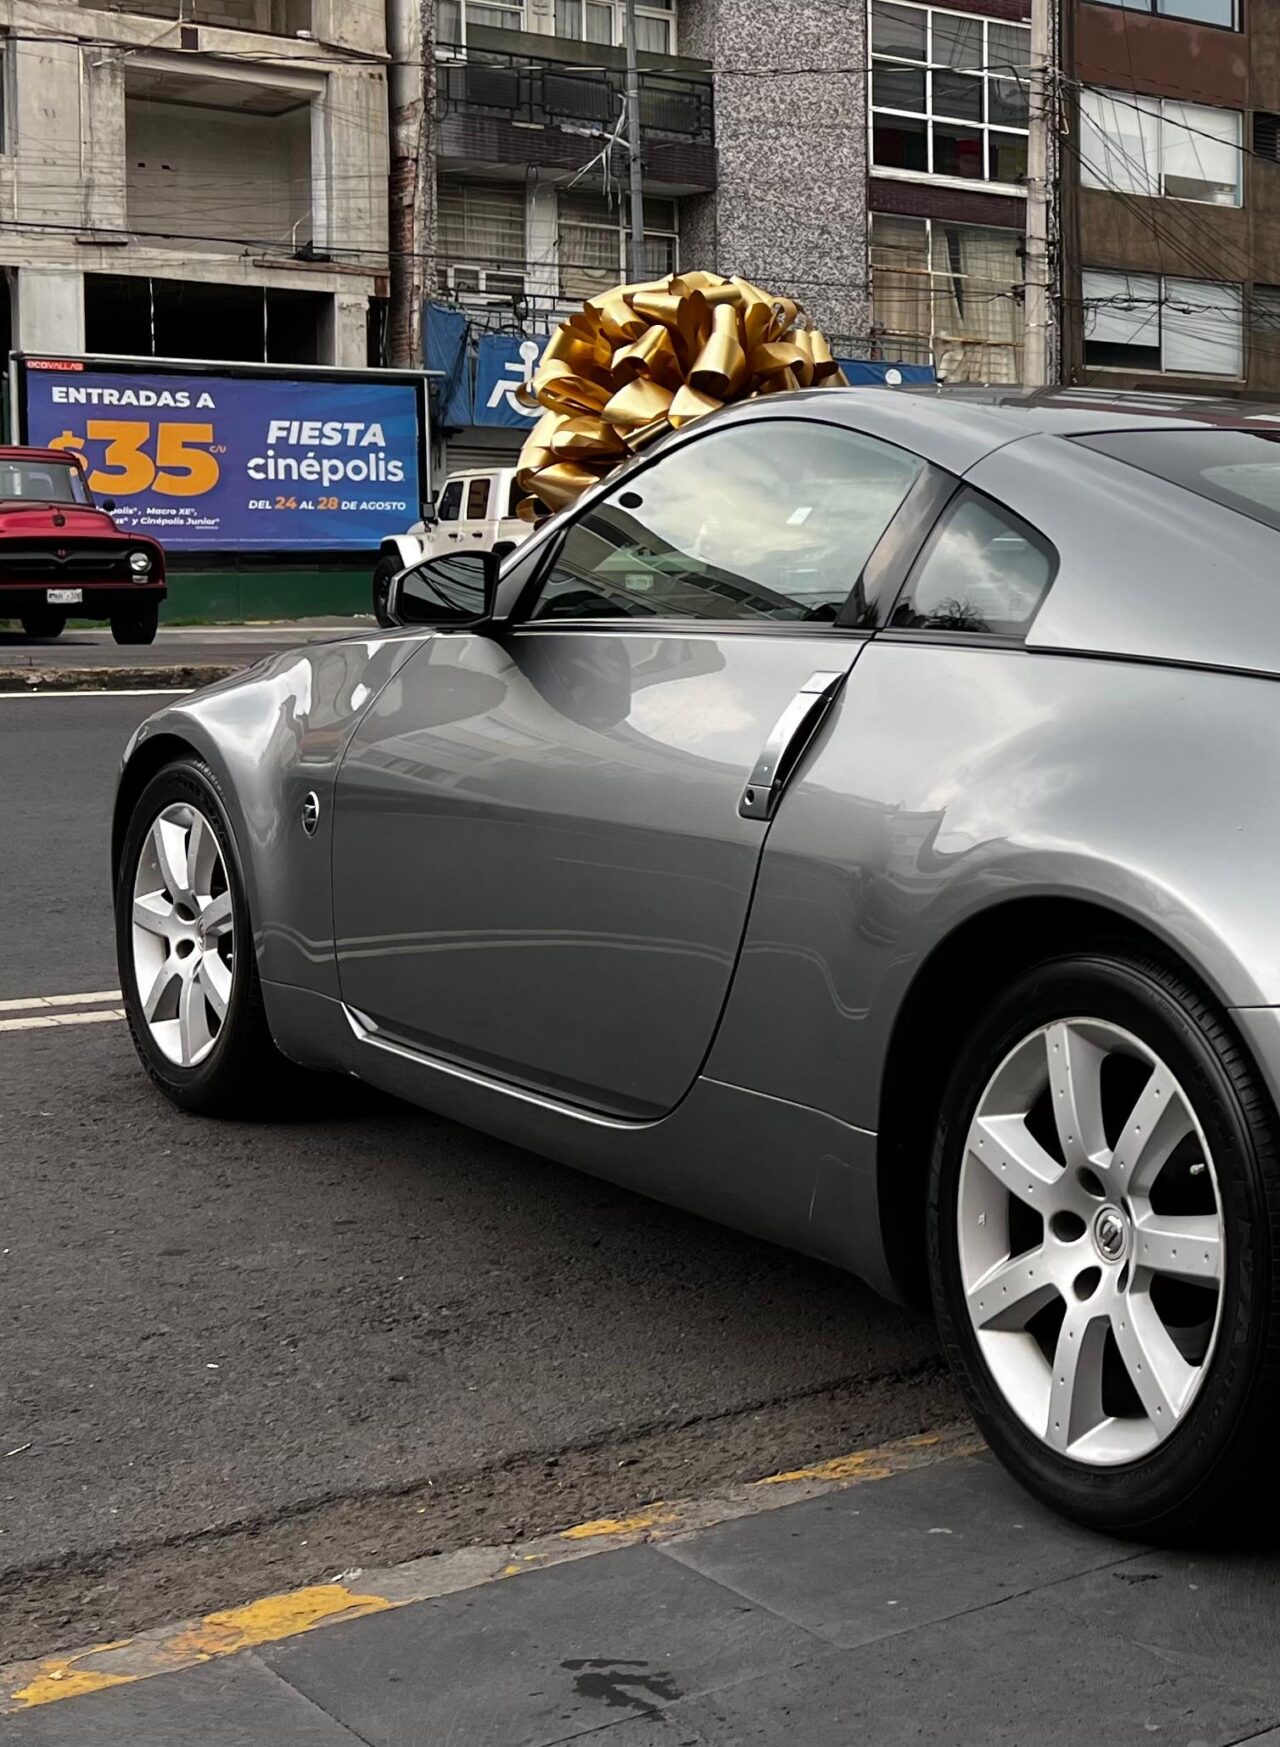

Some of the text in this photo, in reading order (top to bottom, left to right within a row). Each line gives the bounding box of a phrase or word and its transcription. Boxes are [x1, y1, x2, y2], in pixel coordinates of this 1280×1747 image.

[51, 386, 216, 409] ENTRADAS A
[266, 420, 386, 447] FIESTA
[247, 449, 405, 487] cinépolis
[146, 507, 177, 516] Macro
[248, 496, 407, 511] DEL 24 AL 28 DE AGOSTO
[131, 518, 139, 526] y
[140, 516, 185, 526] Cinépolis
